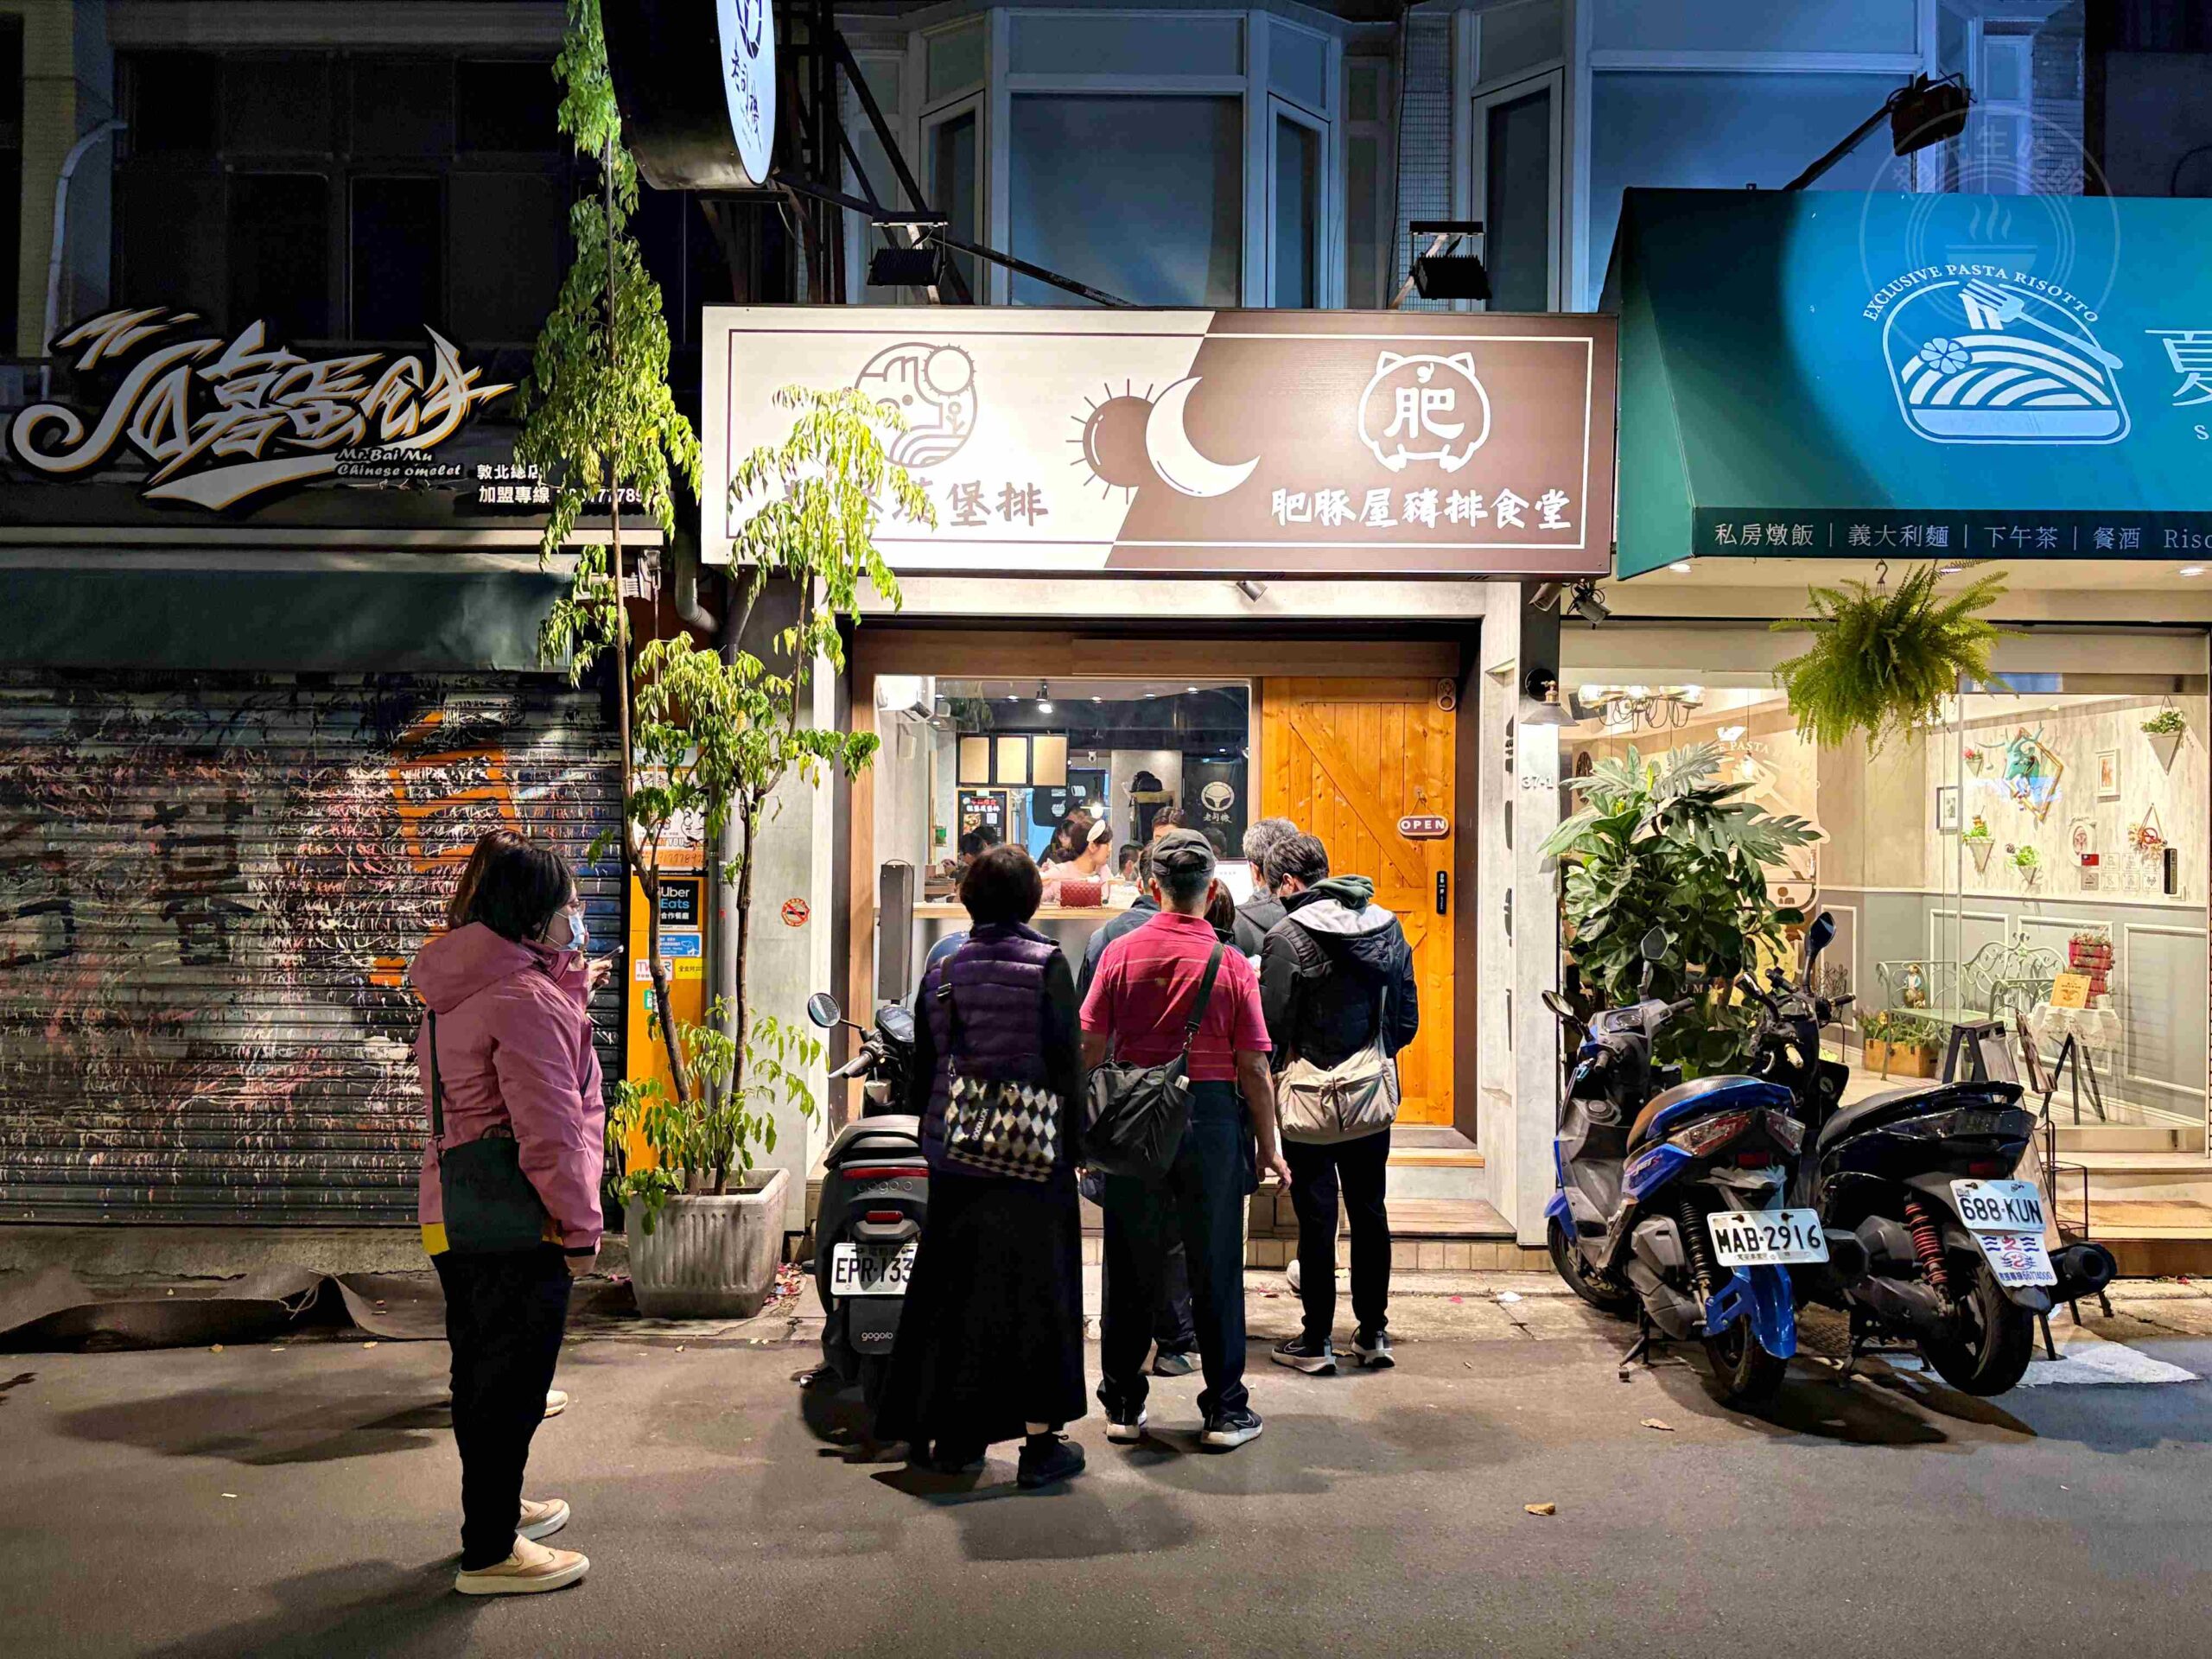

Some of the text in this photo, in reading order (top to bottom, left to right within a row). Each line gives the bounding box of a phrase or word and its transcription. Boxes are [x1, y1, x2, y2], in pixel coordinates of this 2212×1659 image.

[1863, 264, 2099, 323] EXCLUSIVE PASTA RISOTTO
[1384, 386, 1465, 440] 肥
[370, 448, 399, 461] Bai
[403, 449, 433, 461] Mu
[337, 463, 461, 478] Chinese omelet
[1270, 487, 1573, 530] 肥豚屋豬排食堂
[1714, 522, 1815, 548] 私房燉飯
[1847, 524, 1949, 549] 義大利麵
[1984, 525, 2058, 550] 下午茶
[2093, 526, 2142, 550] 餐酒
[1731, 741, 1770, 754] PASTA
[1521, 776, 1554, 790] 37-1
[1400, 819, 1446, 830] OPEN
[663, 887, 690, 898] Uber
[663, 898, 690, 909] Eats
[1960, 1198, 2044, 1224] 688-KUN
[1715, 1224, 1821, 1254] MAB-2916
[861, 1332, 893, 1342] gogoro
